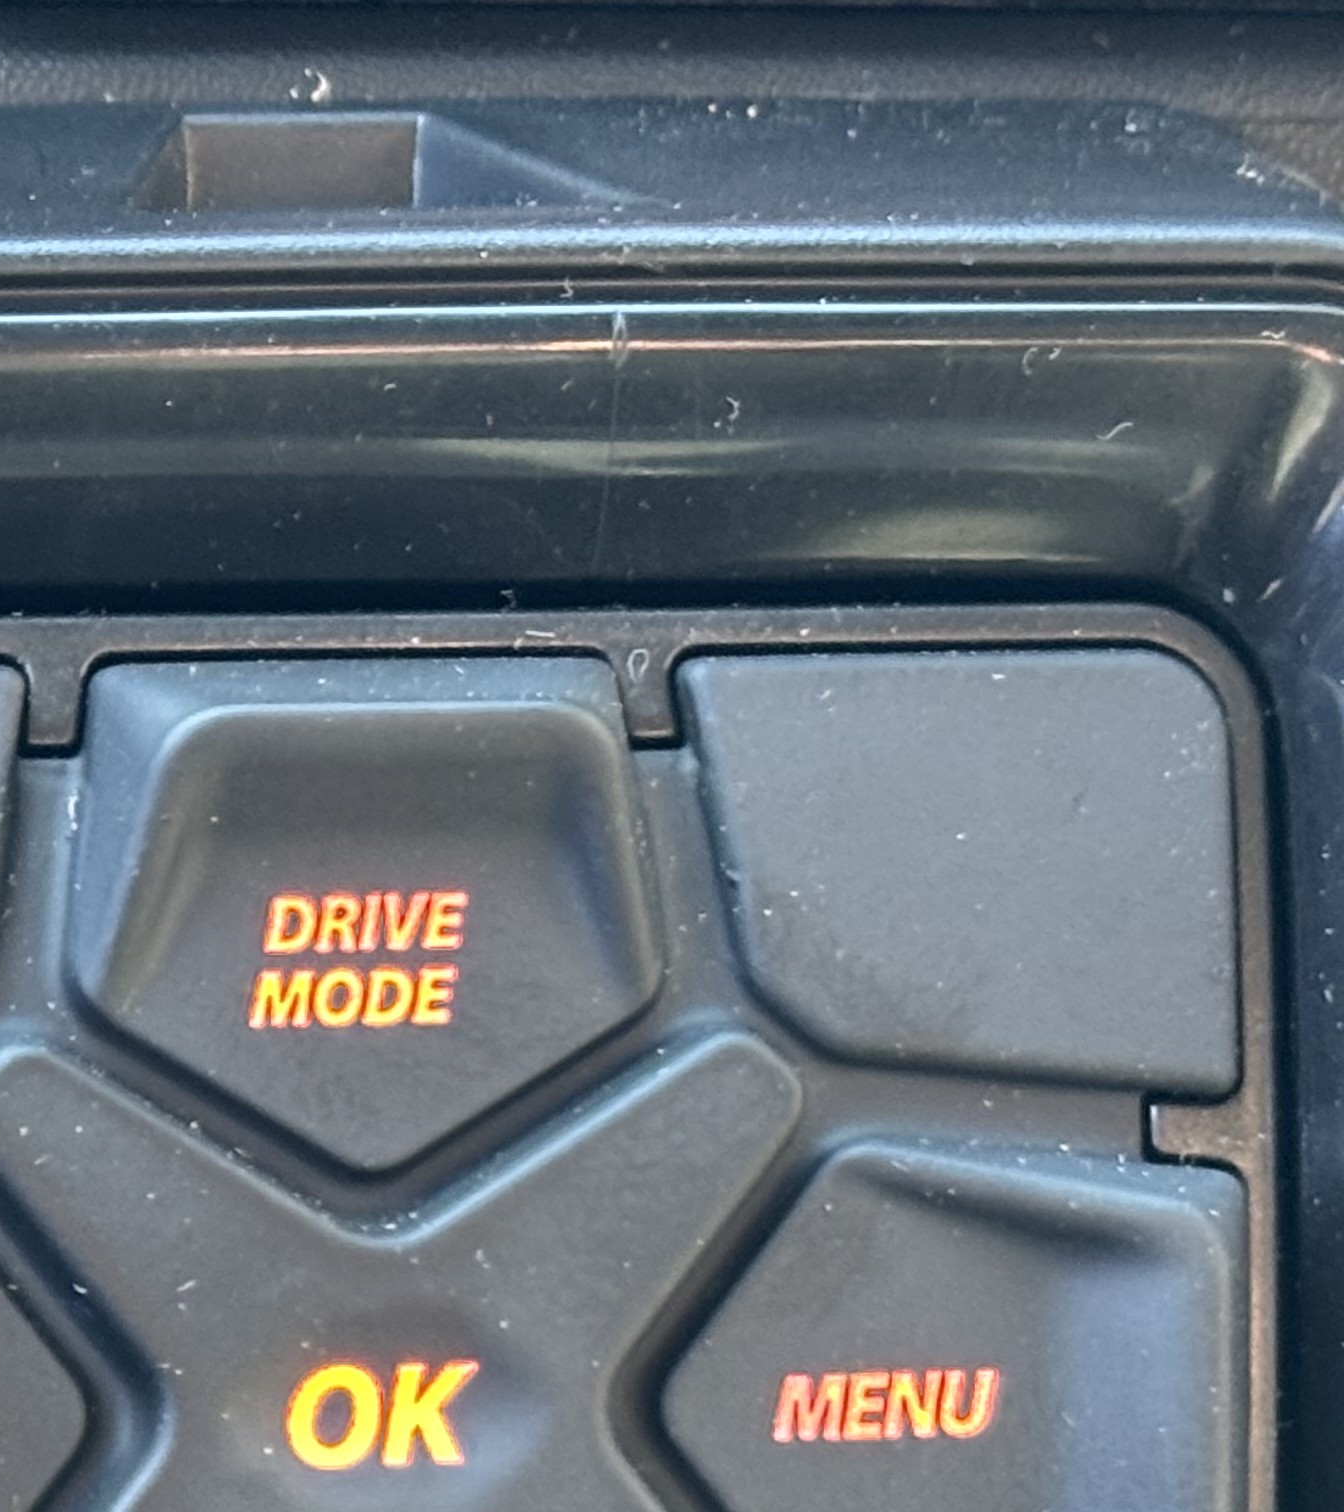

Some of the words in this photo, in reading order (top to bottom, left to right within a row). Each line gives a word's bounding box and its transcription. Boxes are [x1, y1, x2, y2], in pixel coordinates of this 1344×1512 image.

[264, 890, 468, 954] DRIVE
[249, 964, 458, 1029] MODE
[285, 1361, 478, 1470] OK
[772, 1368, 999, 1443] MENU
